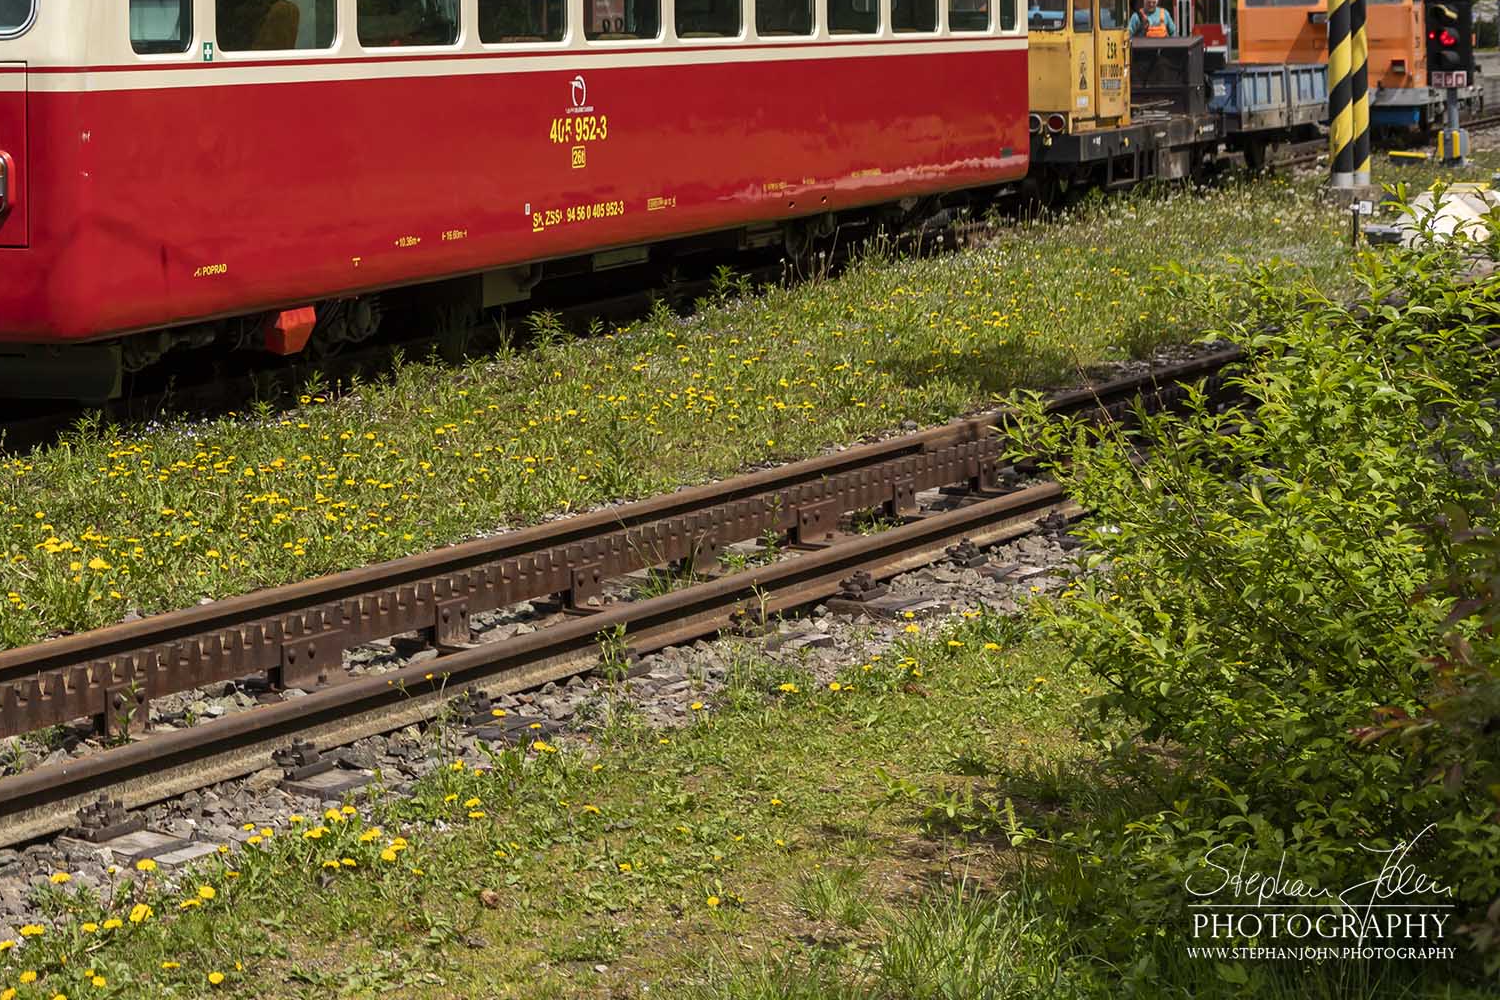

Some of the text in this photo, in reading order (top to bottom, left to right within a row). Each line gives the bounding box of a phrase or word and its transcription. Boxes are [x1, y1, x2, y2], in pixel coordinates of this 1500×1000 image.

[550, 115, 607, 144] 405 952-3
[567, 207, 576, 222] 94
[577, 206, 586, 221] 56
[593, 203, 605, 218] 405
[606, 200, 624, 216] 952-3
[203, 264, 227, 277] POPRAD
